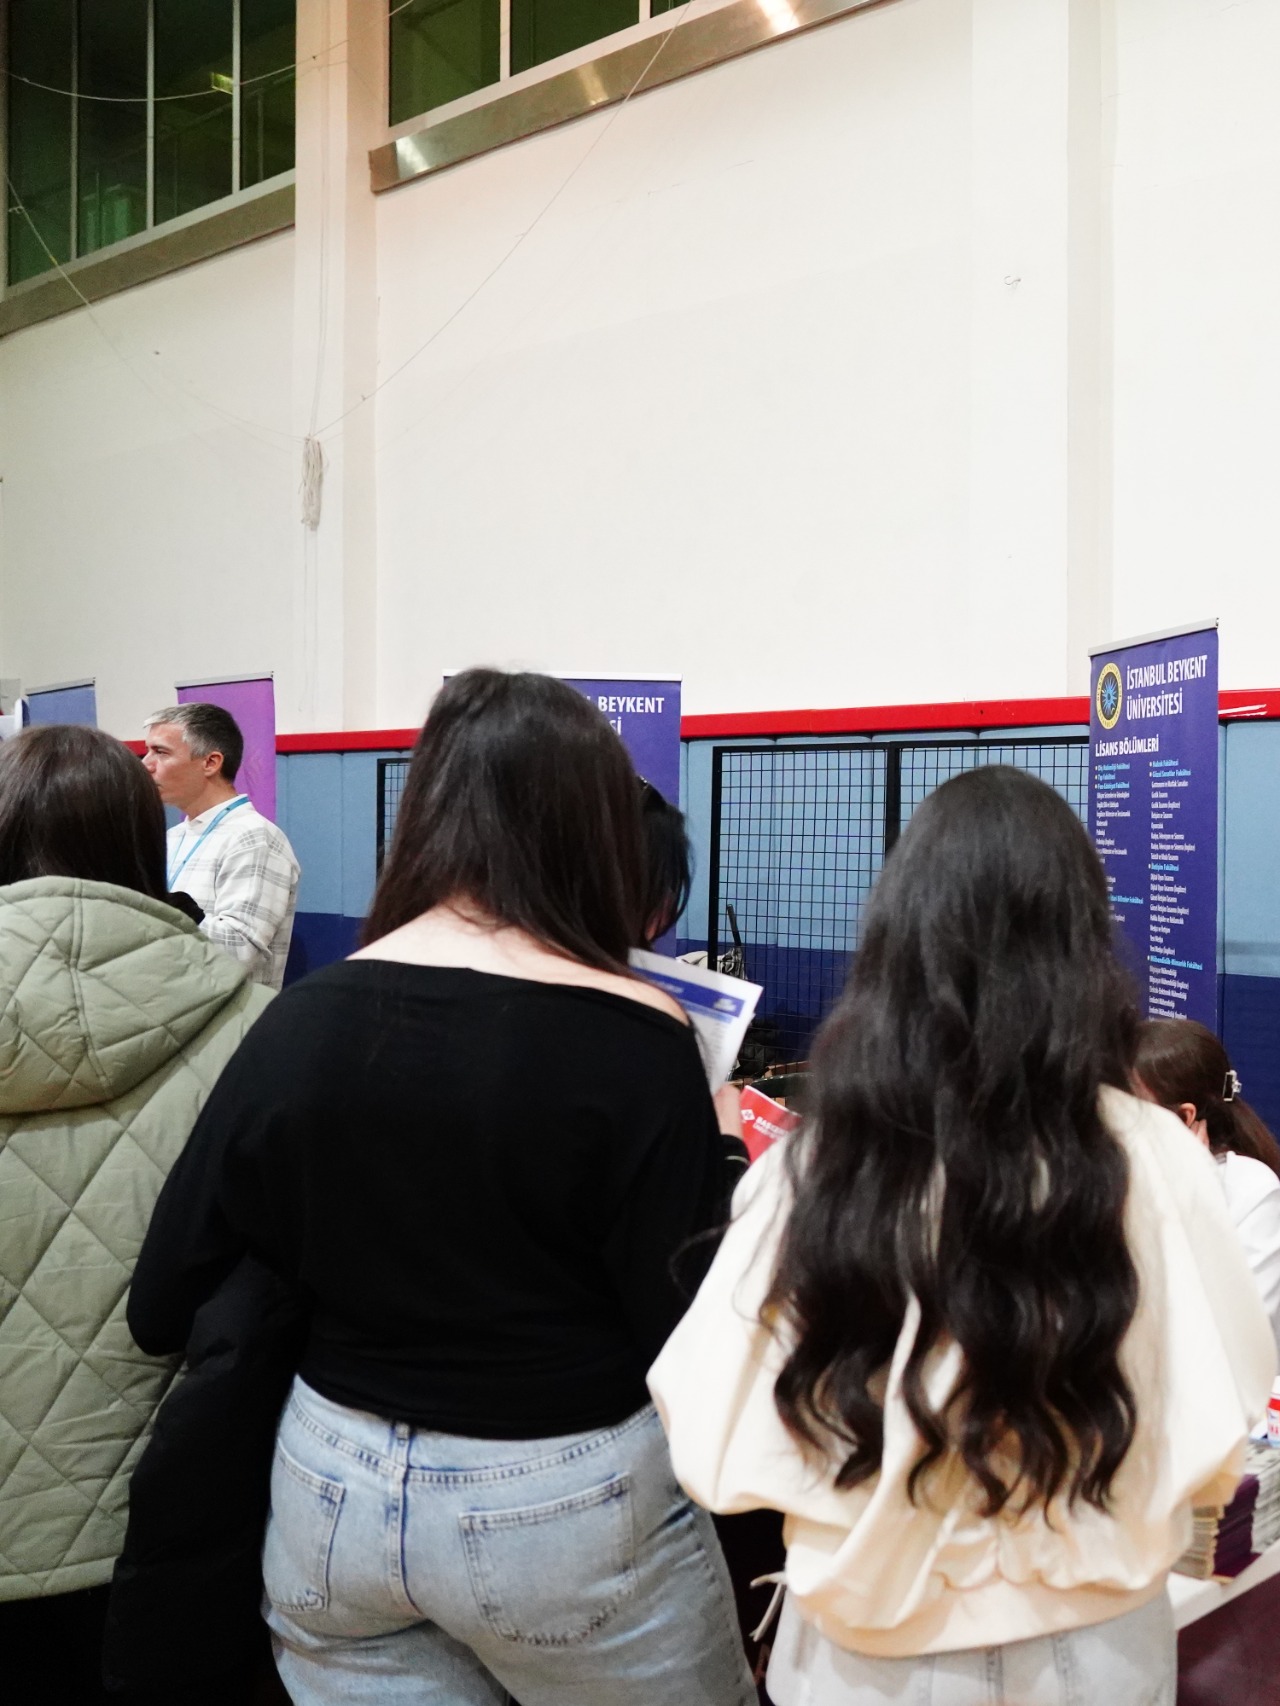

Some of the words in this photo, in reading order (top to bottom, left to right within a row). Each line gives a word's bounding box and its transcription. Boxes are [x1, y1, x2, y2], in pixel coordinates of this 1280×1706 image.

[1126, 663, 1167, 690] İSTANBUL
[1167, 654, 1208, 684] BEYKENT
[597, 695, 665, 713] BEYKENT
[1126, 687, 1183, 721] ÜNİVERSİTESİ
[1095, 740, 1119, 757] LİSANS
[1119, 733, 1159, 754] BÖLÜMLERİ
